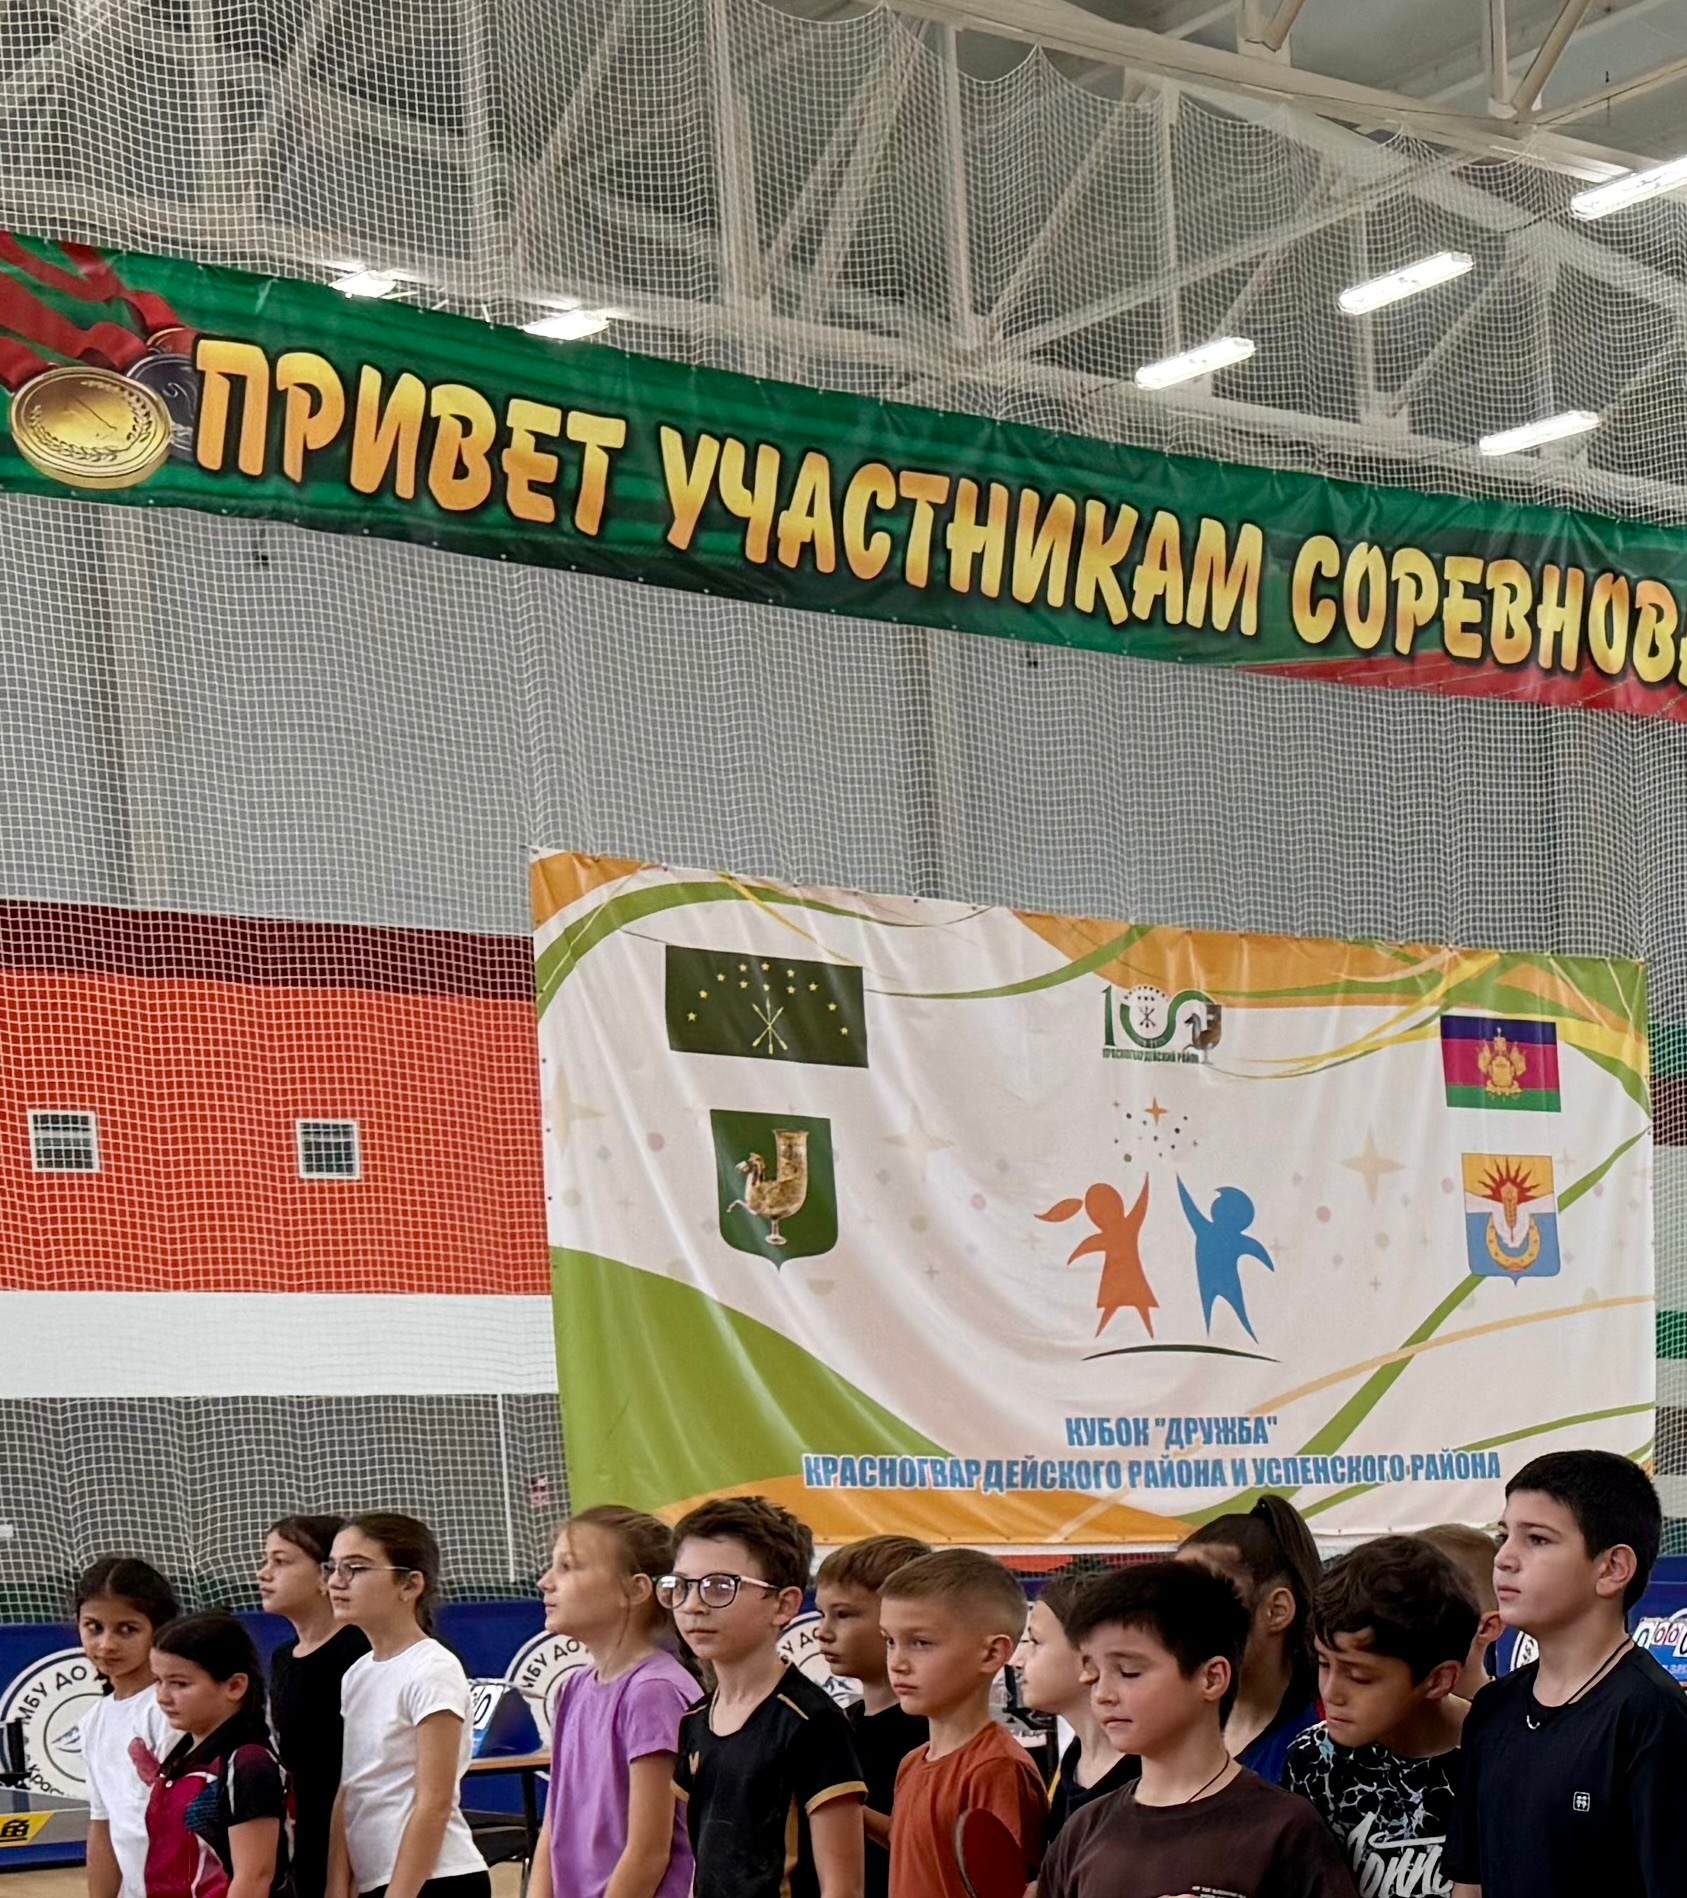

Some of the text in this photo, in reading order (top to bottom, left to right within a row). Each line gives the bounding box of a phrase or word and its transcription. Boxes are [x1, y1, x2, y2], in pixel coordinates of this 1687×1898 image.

[194, 339, 627, 538] ПРИВЕТ
[660, 426, 1267, 638] УЧАСТНИКАМ
[1065, 1416, 1278, 1450] КУБОК "ДРУЖБА"
[803, 1449, 1502, 1493] КРАСНОГВАРДЕЙСКОГО РАЙОНА И УСПЕНСКОГО РАЙОНА
[553, 1639, 581, 1662] ДО
[17, 1664, 88, 1726] МБУ ДО
